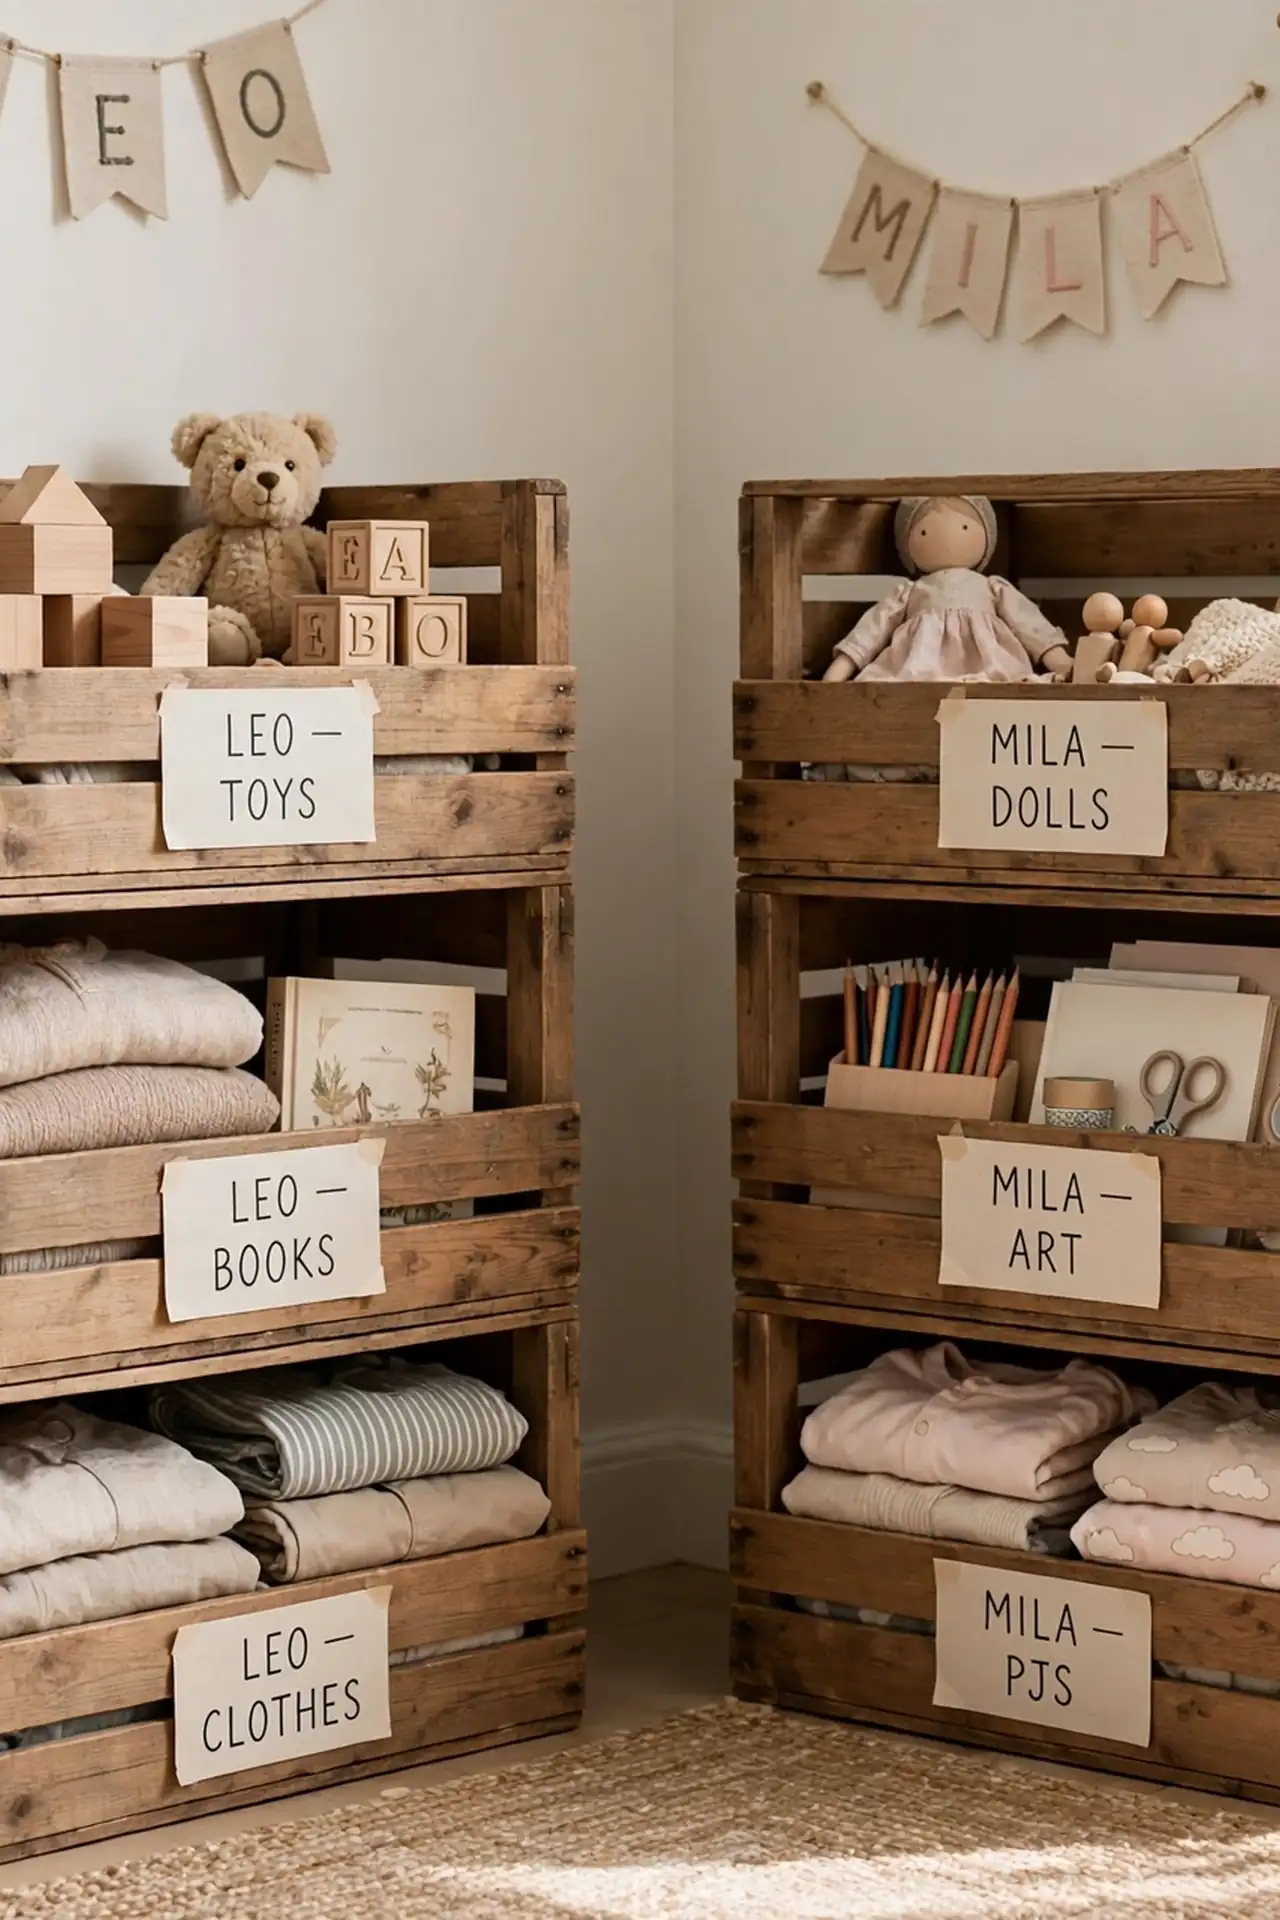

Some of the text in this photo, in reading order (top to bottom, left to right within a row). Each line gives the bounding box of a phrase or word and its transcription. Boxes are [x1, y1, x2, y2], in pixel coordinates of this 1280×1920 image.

[850, 183, 1194, 293] MILA
[379, 536, 416, 582] A
[226, 712, 294, 757] LEO
[991, 723, 1086, 768] MILA
[219, 777, 316, 822] TOYS
[992, 785, 1110, 831] DOLLS
[231, 1174, 298, 1224] LEO
[992, 1164, 1085, 1215] MILA
[214, 1233, 335, 1292] BOOKS
[1008, 1228, 1083, 1276] ART
[984, 1589, 1077, 1647] MILA
[243, 1626, 308, 1681] LEO
[1006, 1654, 1073, 1707] PJS
[202, 1678, 361, 1753] CLOTHES
